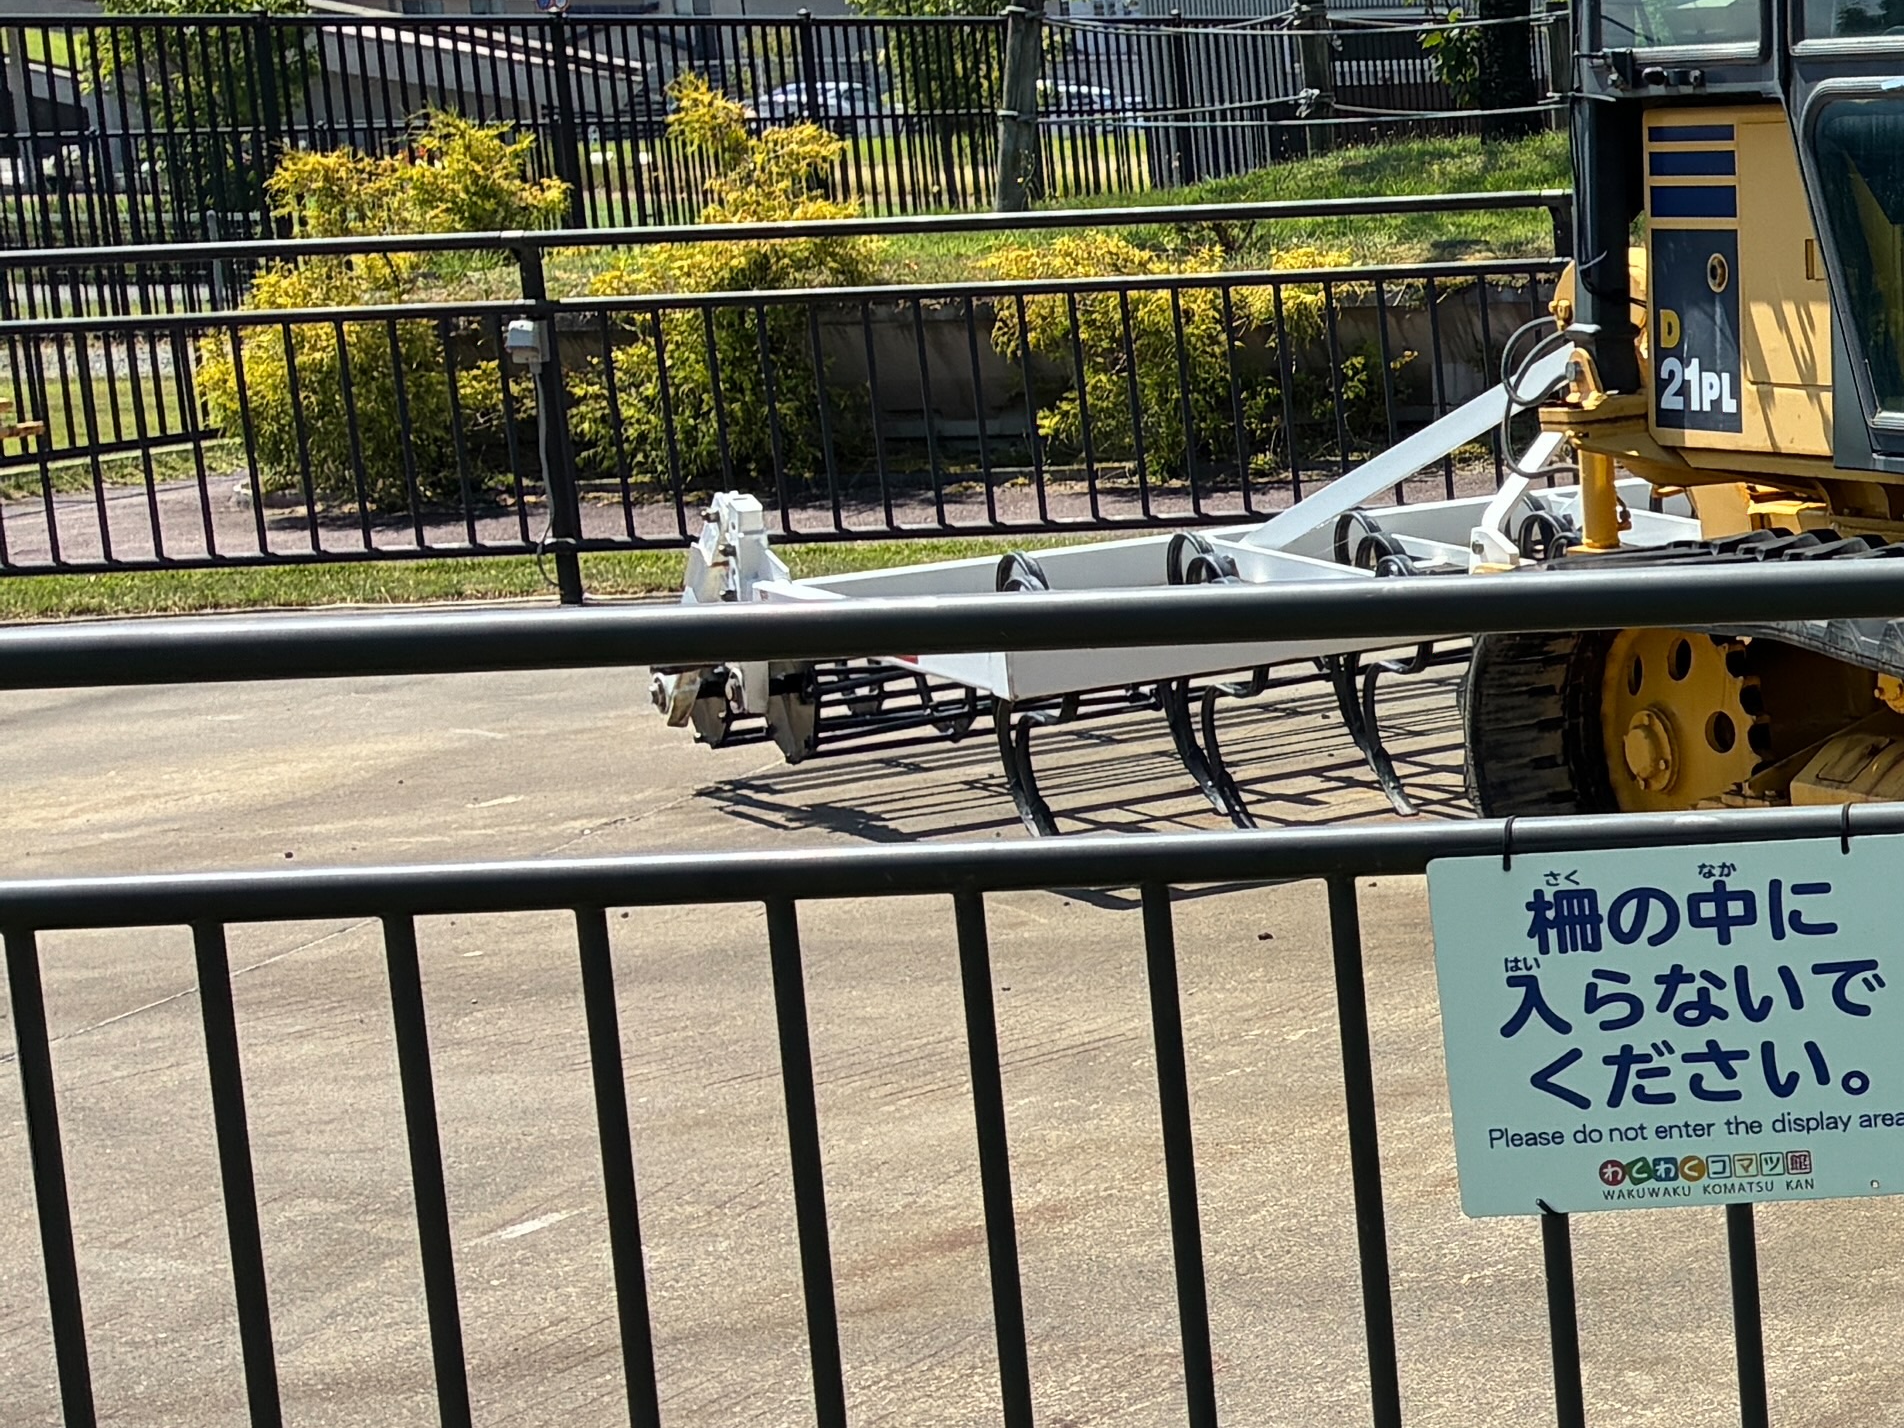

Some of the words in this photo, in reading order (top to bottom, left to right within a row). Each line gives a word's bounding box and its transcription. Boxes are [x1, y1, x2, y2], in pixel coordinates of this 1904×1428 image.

[1660, 309, 1680, 348] D
[1660, 357, 1737, 413] 21PL
[1543, 869, 1580, 887] さく
[1697, 861, 1737, 878] なか
[1524, 878, 1839, 956] 柵の中に
[1503, 956, 1541, 973] はい
[1499, 958, 1887, 1039] 入らないで
[1530, 1038, 1871, 1111] ください。
[1488, 1127, 1565, 1149] Please
[1573, 1124, 1603, 1144] do
[1609, 1122, 1648, 1143] not
[1655, 1119, 1716, 1141] enter
[1724, 1115, 1763, 1136] the
[1771, 1110, 1852, 1135] display
[1600, 1151, 1811, 1185] わくわくコマツ館
[1602, 1185, 1692, 1200] WAKUWAKU
[1702, 1179, 1774, 1195] KOMATSU
[1786, 1178, 1814, 1191] KAN
